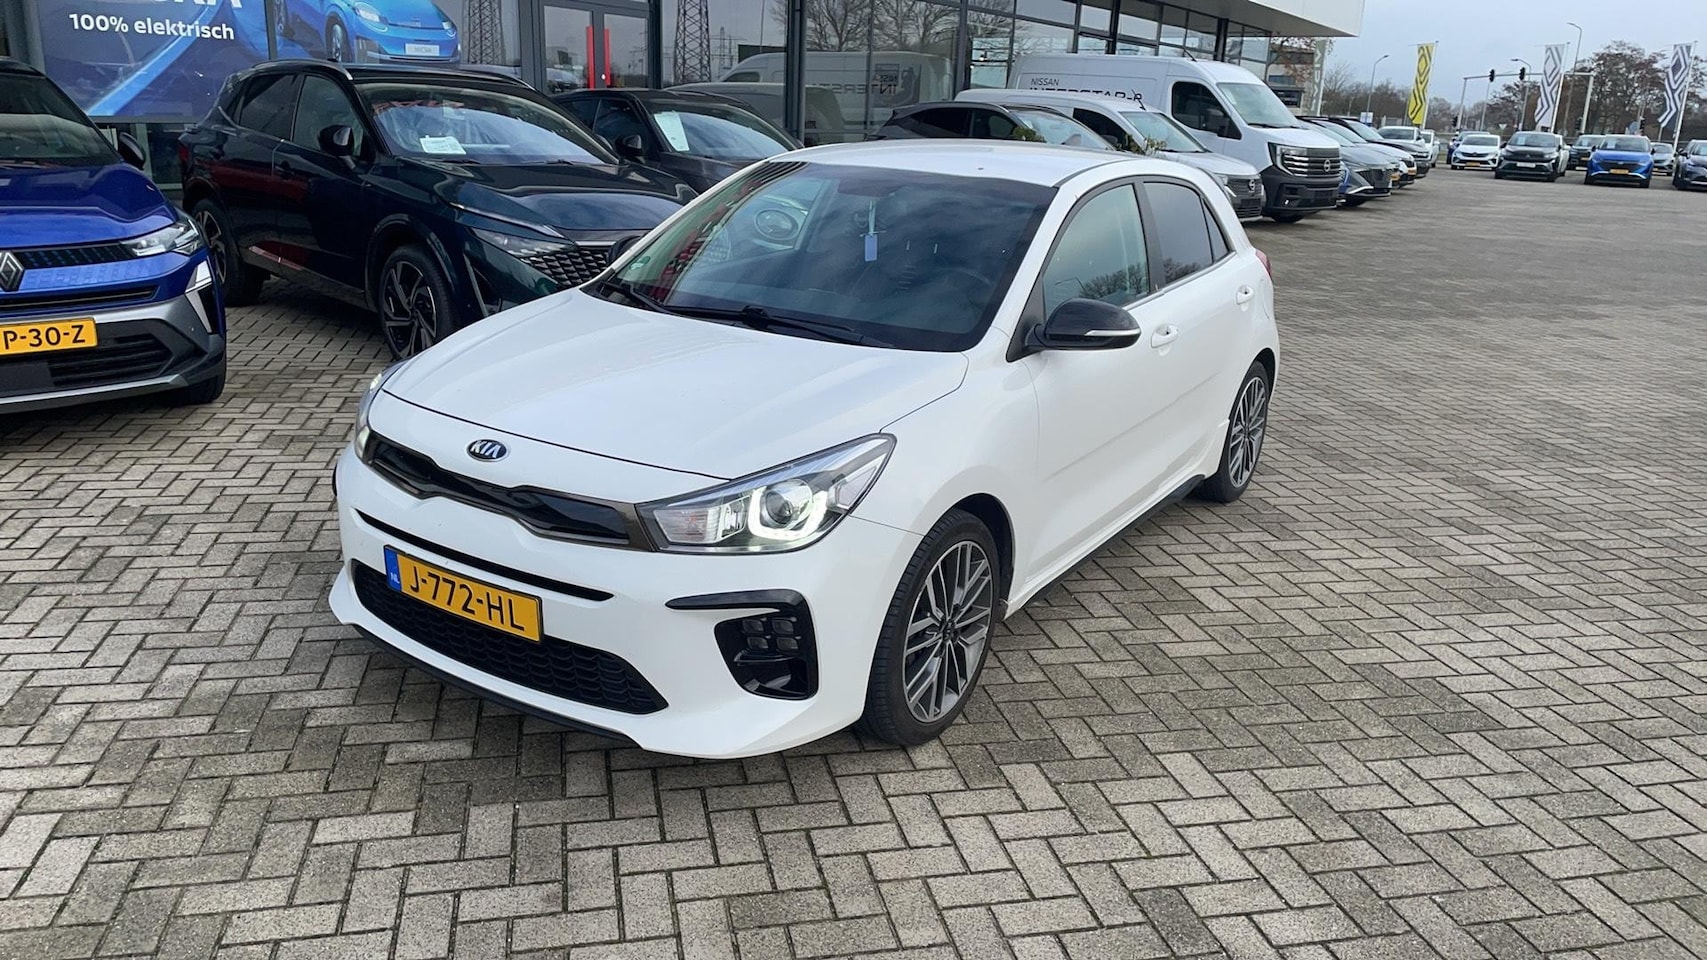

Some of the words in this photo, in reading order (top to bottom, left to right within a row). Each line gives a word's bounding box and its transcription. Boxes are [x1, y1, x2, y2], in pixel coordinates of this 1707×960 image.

[69, 13, 129, 33] 100%
[134, 17, 235, 40] elektrisch
[1030, 77, 1060, 86] NISSAN
[3, 324, 86, 350] P-30-Z
[470, 440, 502, 459] KIA
[390, 571, 400, 585] NL
[410, 565, 525, 632] J-772-HL
